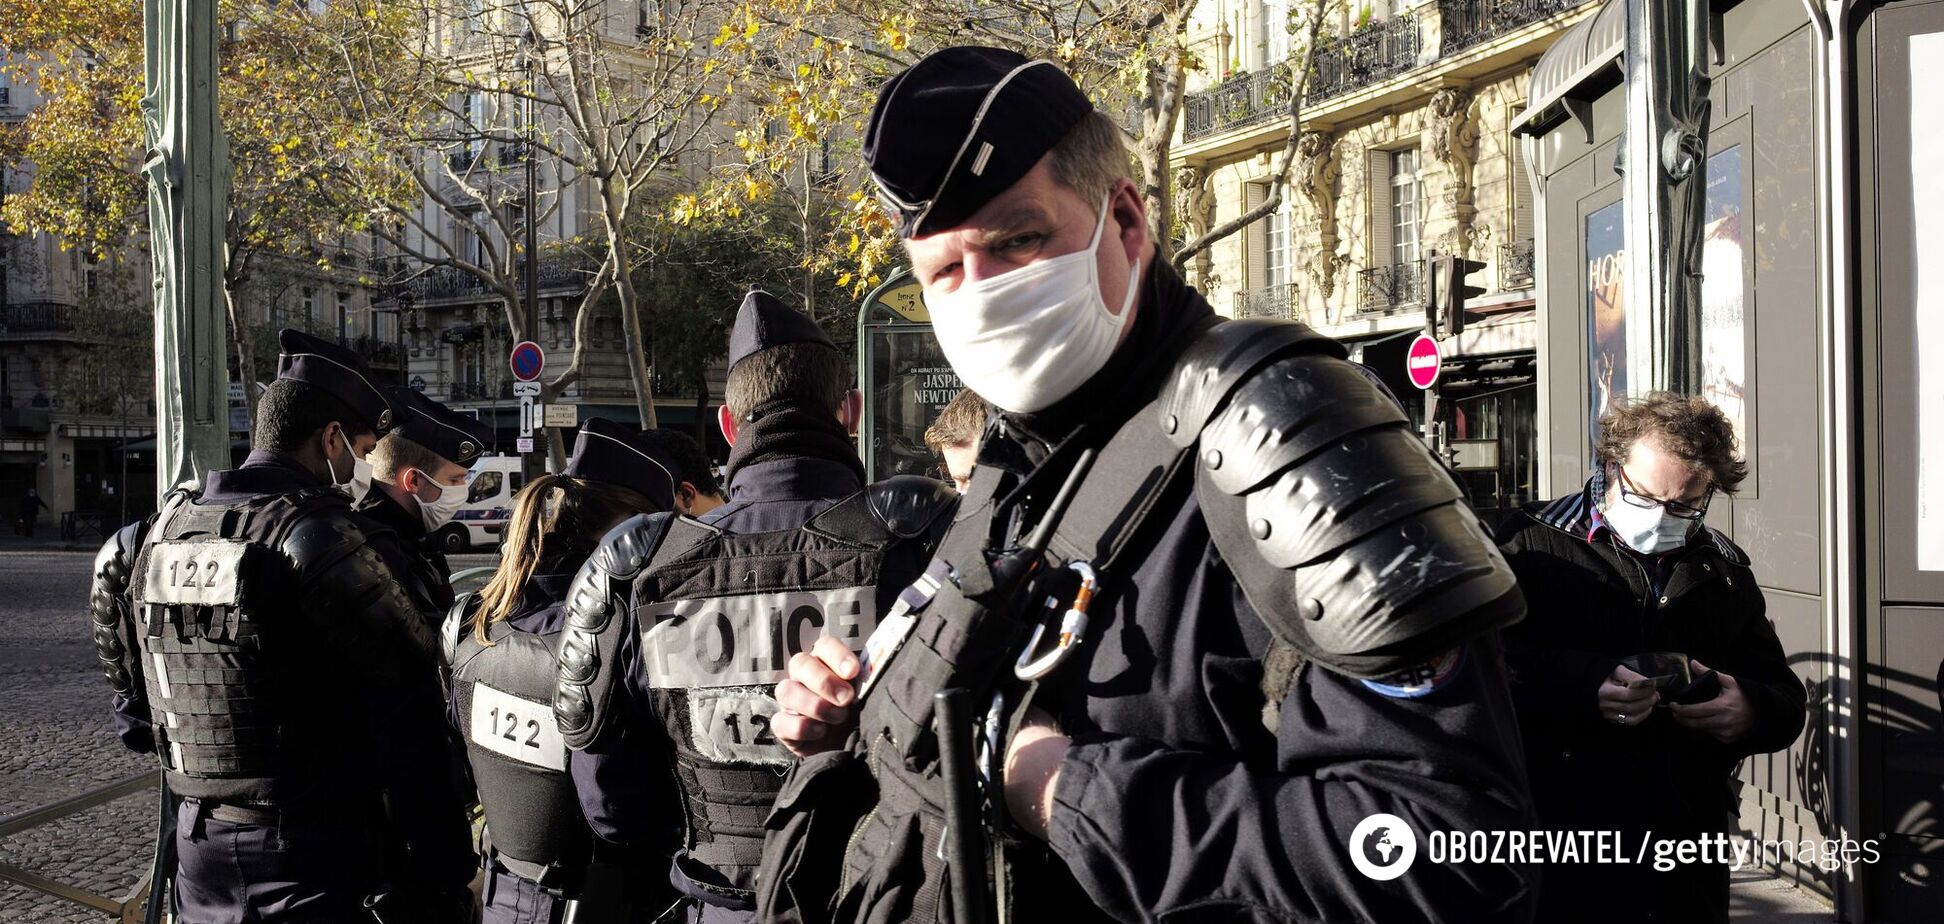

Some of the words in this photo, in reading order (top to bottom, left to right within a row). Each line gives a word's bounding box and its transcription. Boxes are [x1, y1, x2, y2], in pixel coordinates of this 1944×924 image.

[169, 560, 219, 588] 122
[655, 600, 861, 676] POLICE
[490, 707, 540, 749] 122
